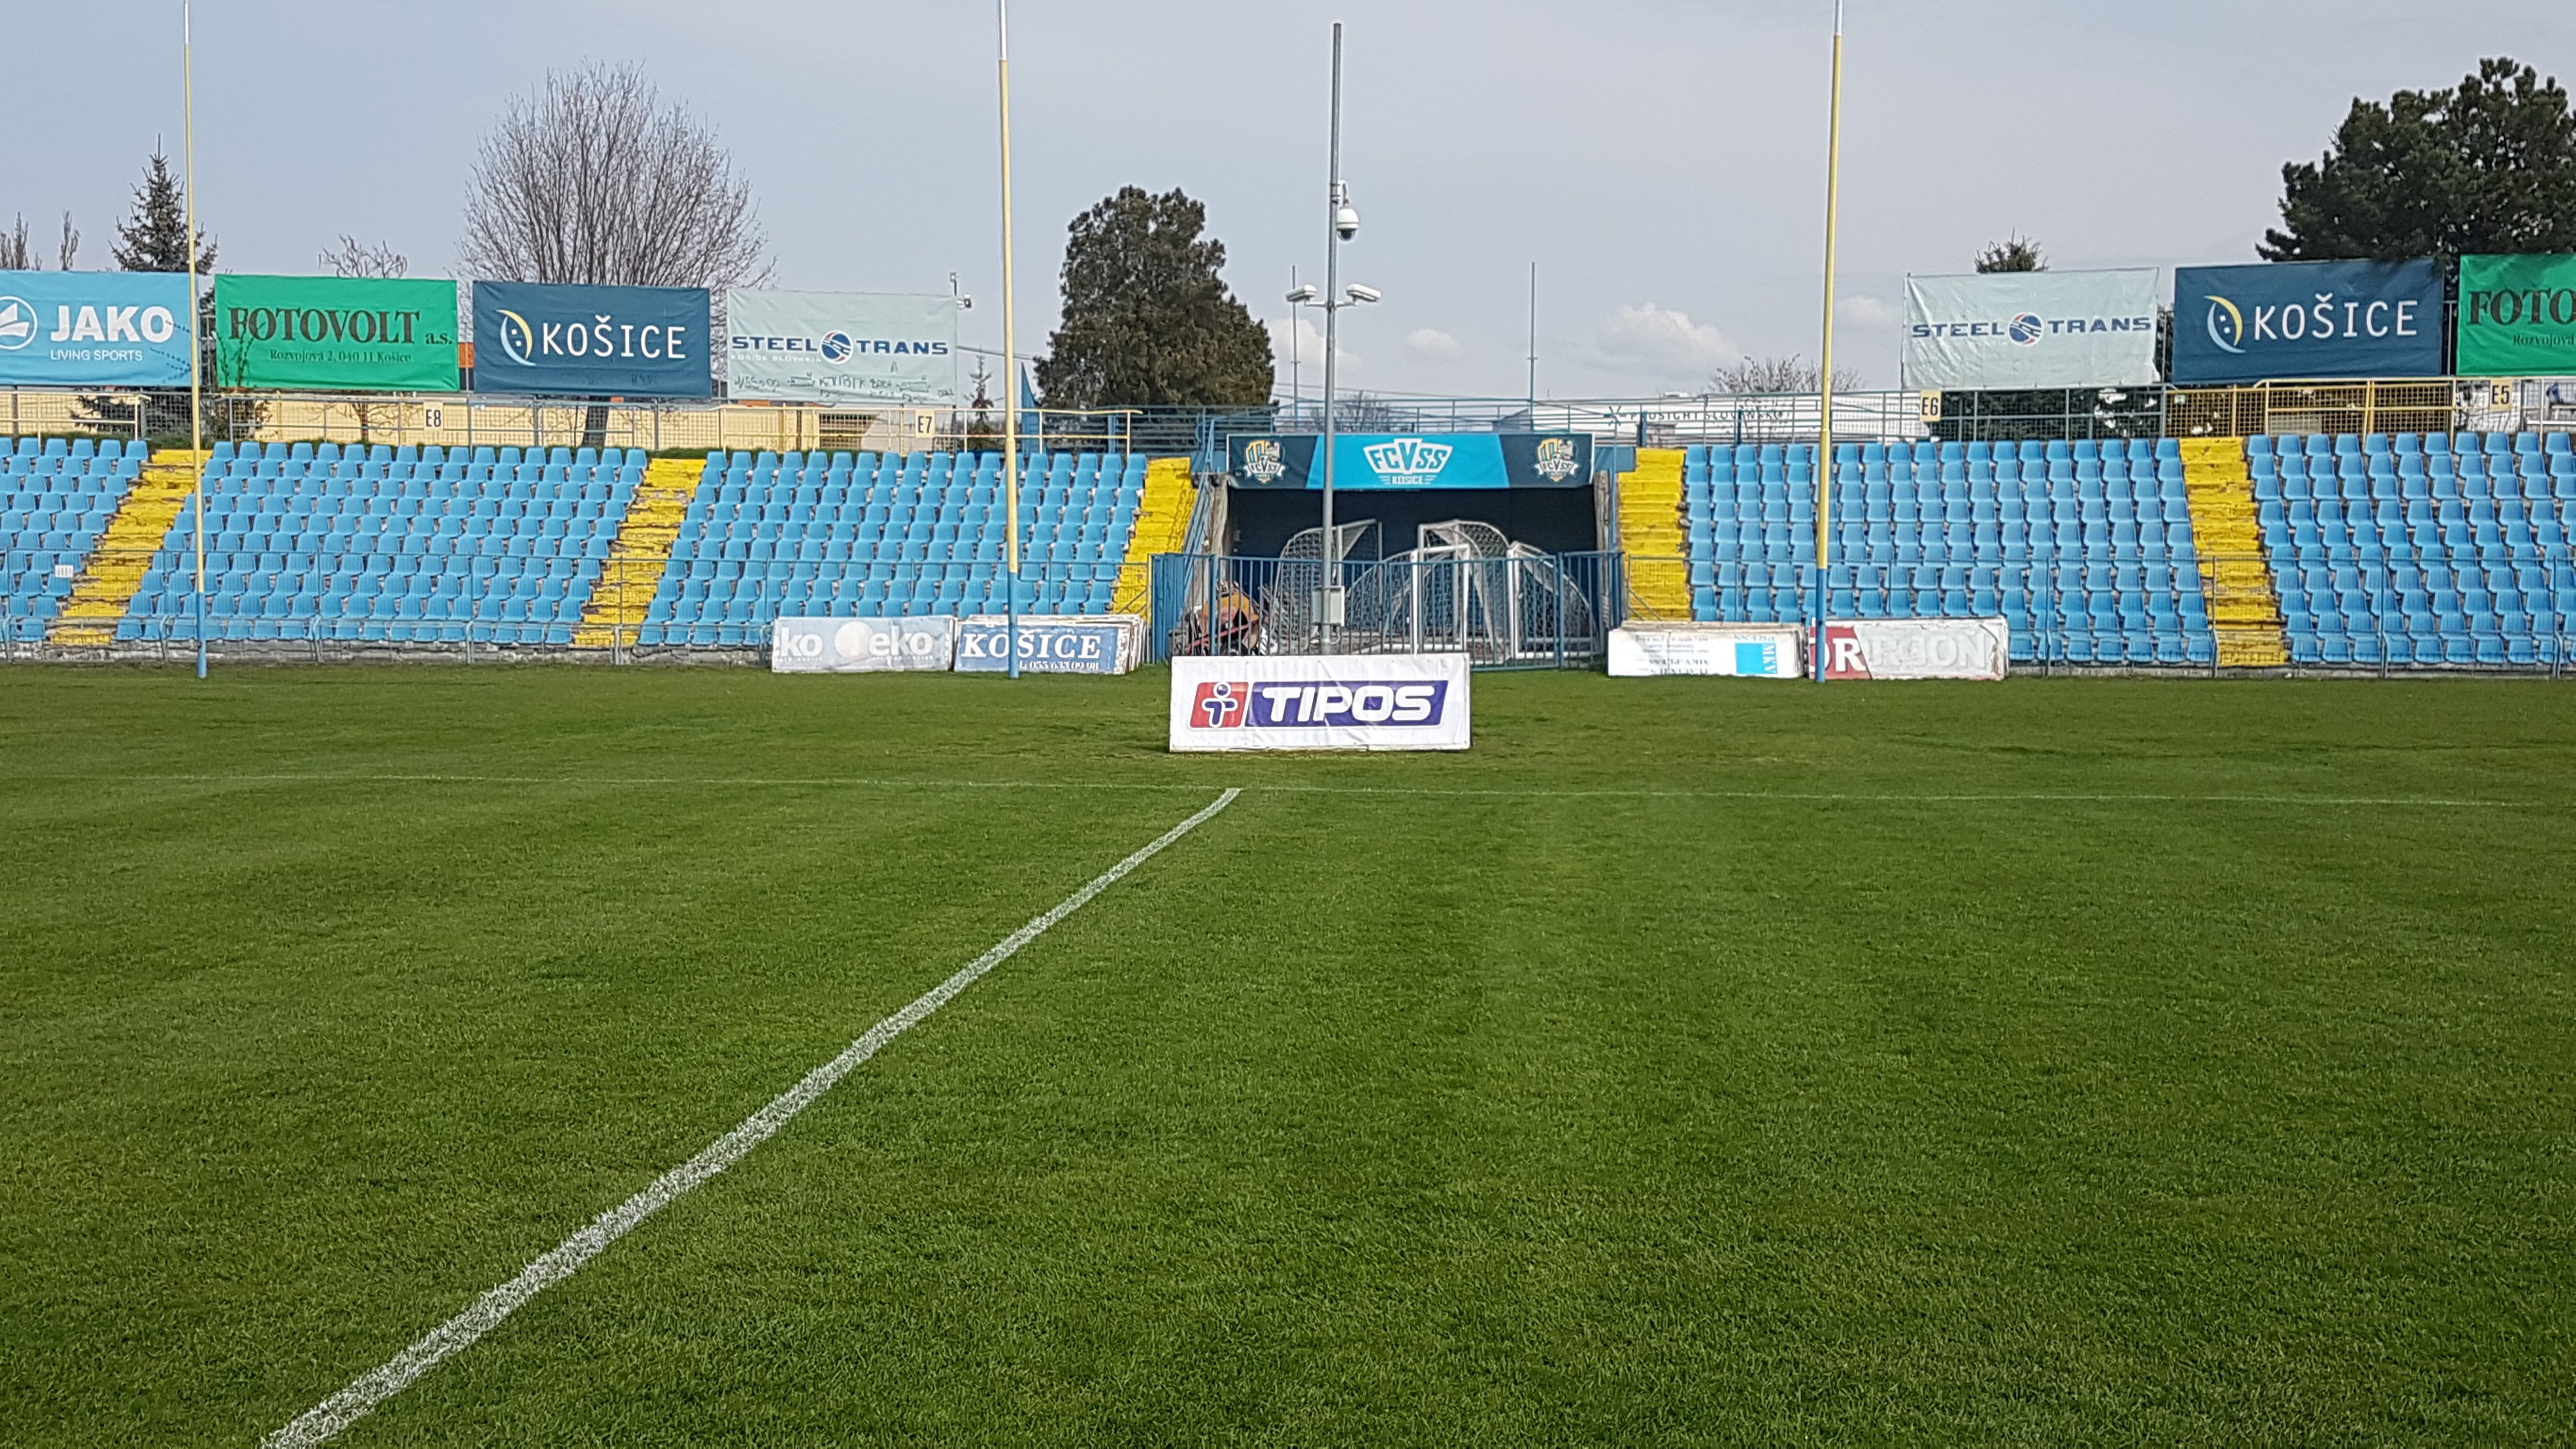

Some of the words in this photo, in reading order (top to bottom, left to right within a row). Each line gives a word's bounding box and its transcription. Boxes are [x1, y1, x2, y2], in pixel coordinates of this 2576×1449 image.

[51, 305, 174, 342] JAKO
[227, 307, 420, 344] FOTOVOLT
[425, 332, 452, 345] a.s.
[2253, 292, 2418, 341] KOŠICE
[543, 314, 686, 358] KOŠICE
[1912, 322, 2005, 337] STEEL
[2047, 317, 2151, 334] TRANS
[50, 349, 90, 360] LIVING
[94, 350, 142, 361] SPORTS
[732, 336, 818, 351] STEEL
[856, 340, 948, 355] TRANS
[2492, 385, 2510, 404] E5
[1921, 396, 1939, 416] E6
[425, 409, 441, 427] E8
[918, 415, 932, 433] E7
[961, 629, 1101, 659] KOŠICE
[1262, 686, 1435, 722] TIPOS
